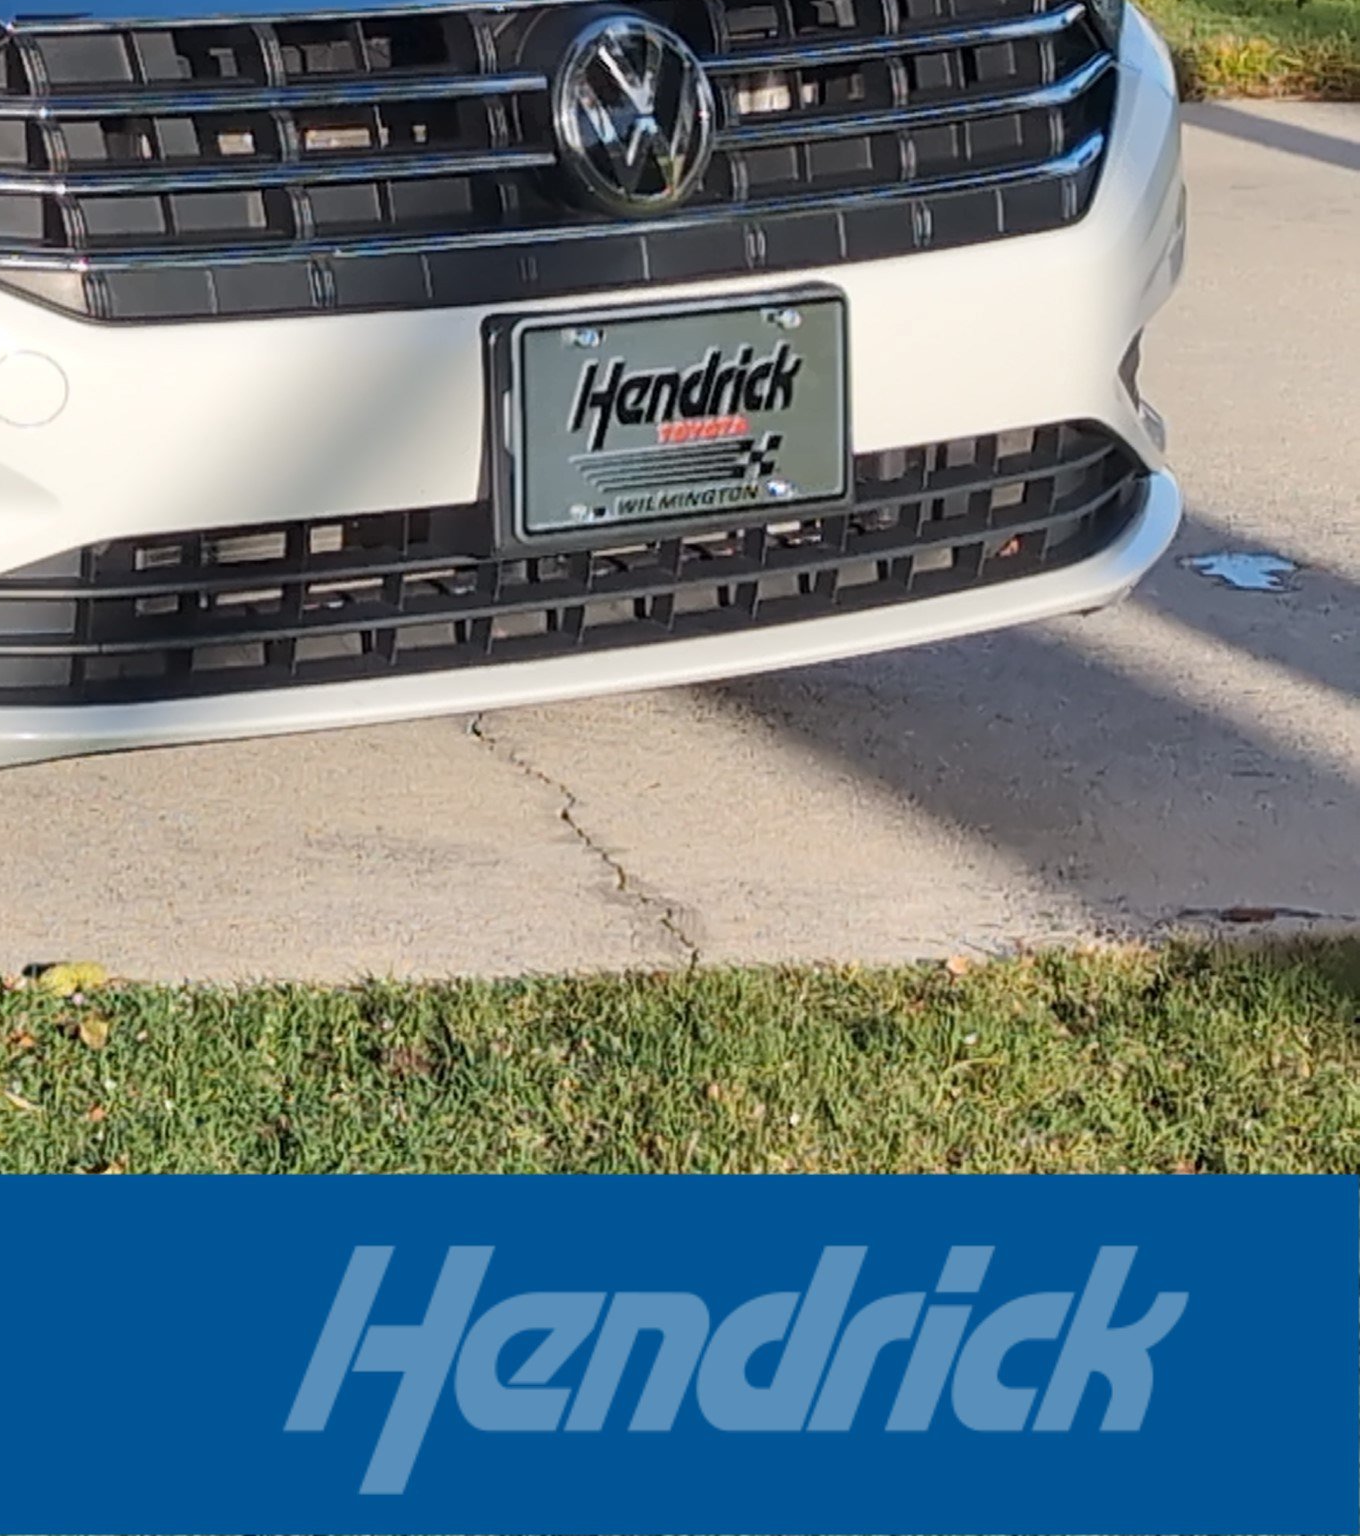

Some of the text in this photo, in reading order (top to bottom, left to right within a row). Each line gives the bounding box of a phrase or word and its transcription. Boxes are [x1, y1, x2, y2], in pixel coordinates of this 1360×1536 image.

[568, 339, 803, 451] Hendrick
[657, 415, 750, 444] TOYOTA
[616, 484, 760, 517] WILMINGTON
